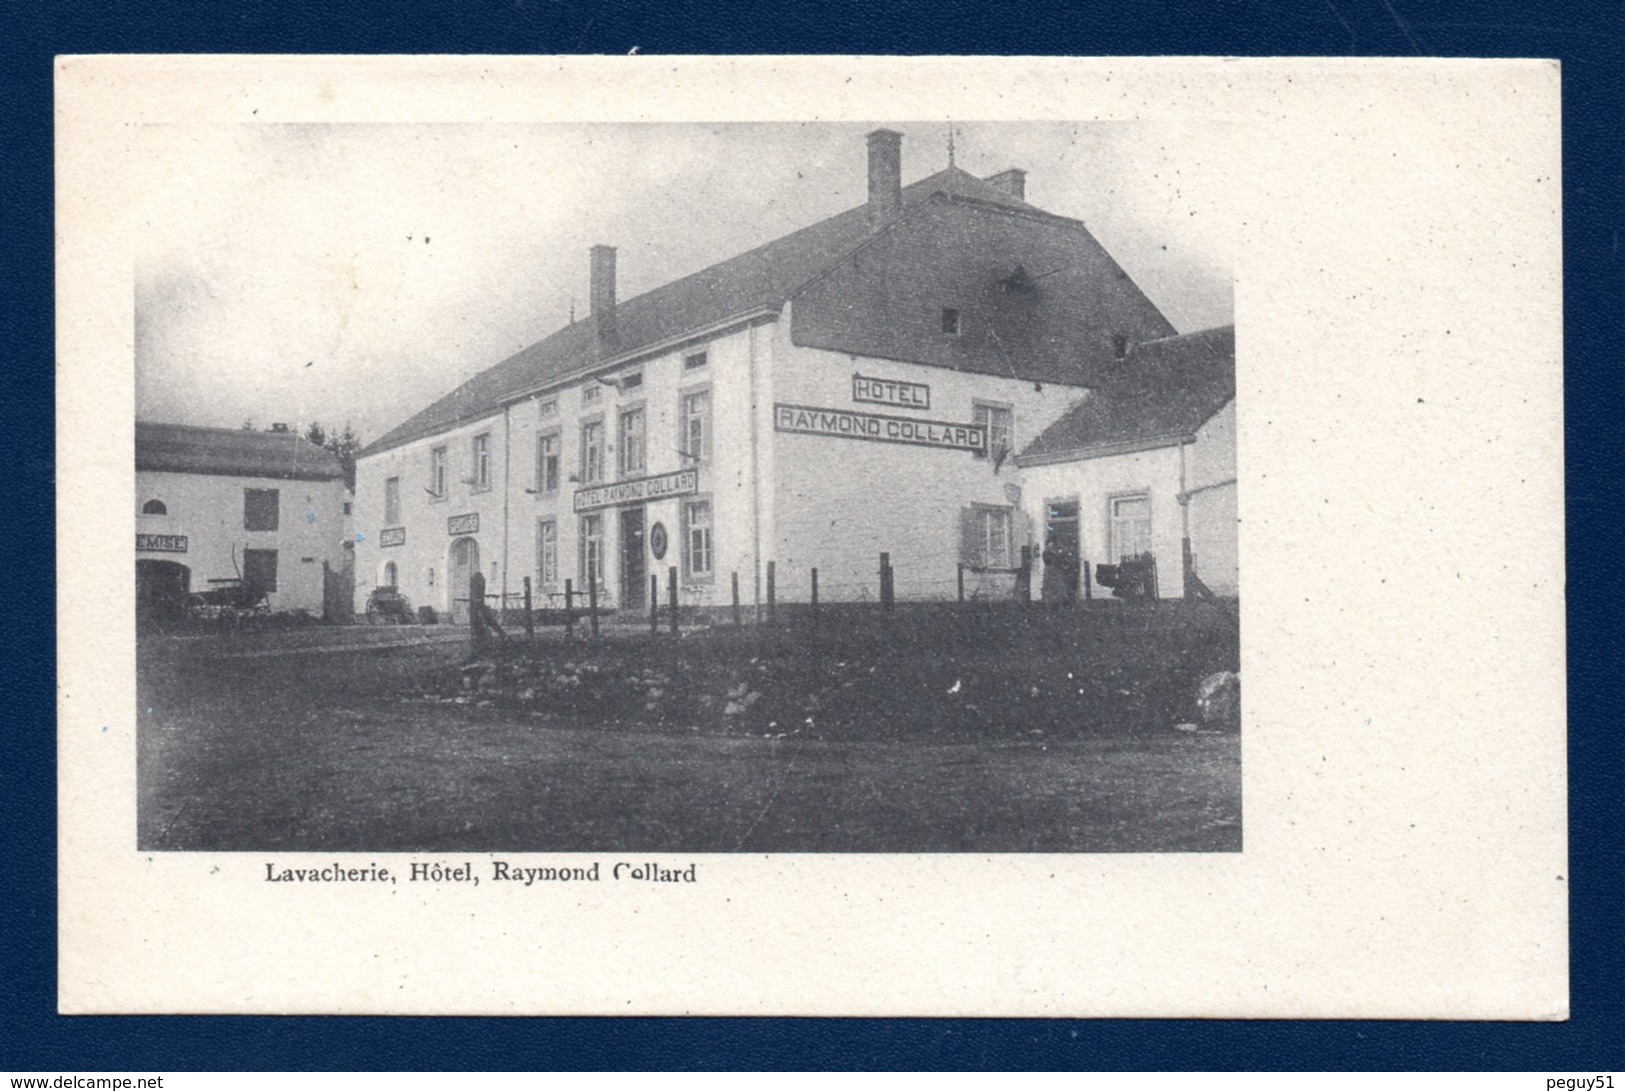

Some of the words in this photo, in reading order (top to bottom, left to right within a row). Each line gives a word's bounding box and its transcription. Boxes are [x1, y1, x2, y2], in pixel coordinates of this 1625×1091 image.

[857, 381, 924, 404] HOTEL
[779, 409, 881, 436] RAYMOND
[886, 420, 981, 447] COLLARD
[604, 482, 643, 502] RAYMOND
[647, 473, 695, 497] COLLARD
[265, 863, 397, 885] Lavacherie,
[409, 862, 480, 886] Hôtel,
[492, 862, 600, 886] Raymond
